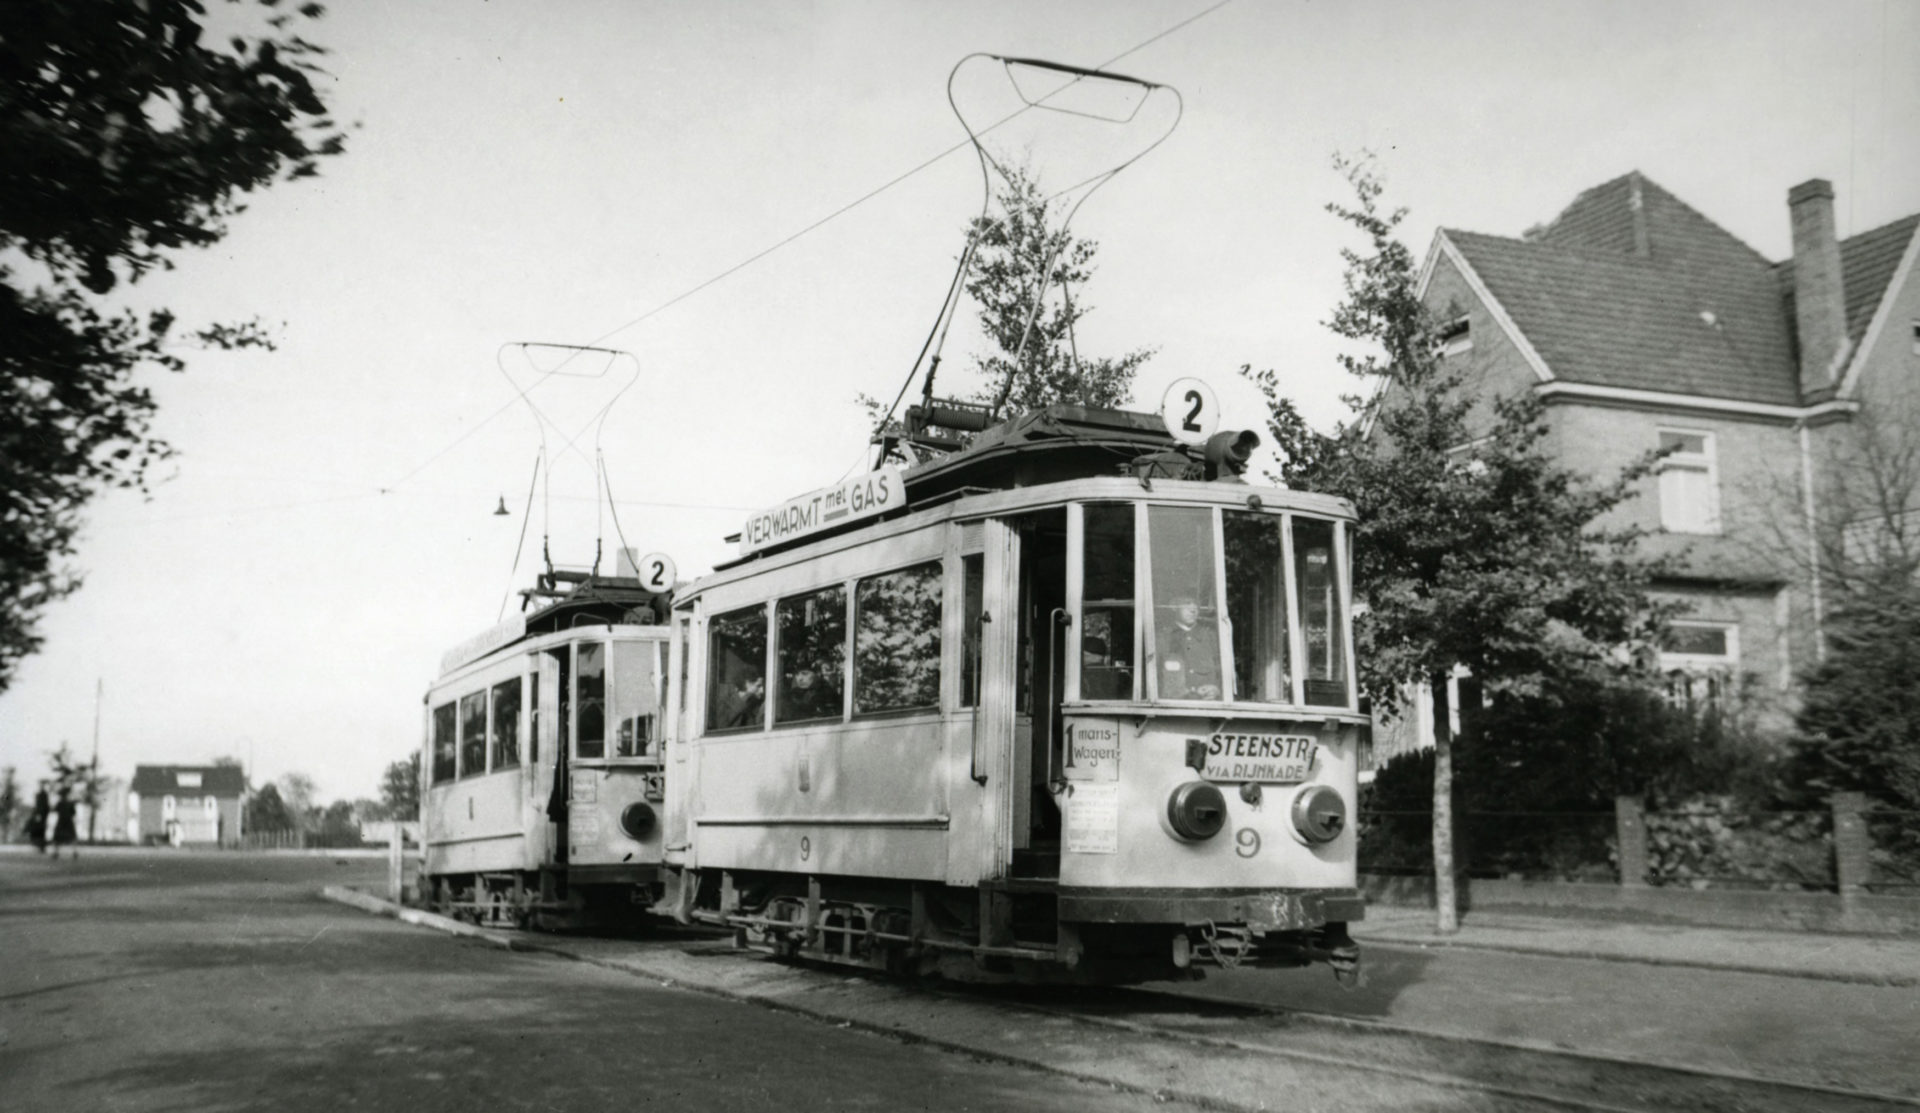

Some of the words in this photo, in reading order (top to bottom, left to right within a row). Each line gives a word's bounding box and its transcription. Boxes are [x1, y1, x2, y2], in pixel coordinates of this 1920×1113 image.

[1182, 389, 1203, 433] 2
[746, 497, 822, 545] VERWARMT
[824, 486, 847, 510] met
[851, 475, 890, 513] GAS
[651, 560, 665, 586] 2
[1206, 765, 1230, 778] VIA
[1232, 763, 1304, 780] RIJNKADE
[800, 835, 811, 862] 9
[1235, 826, 1262, 859] 9
